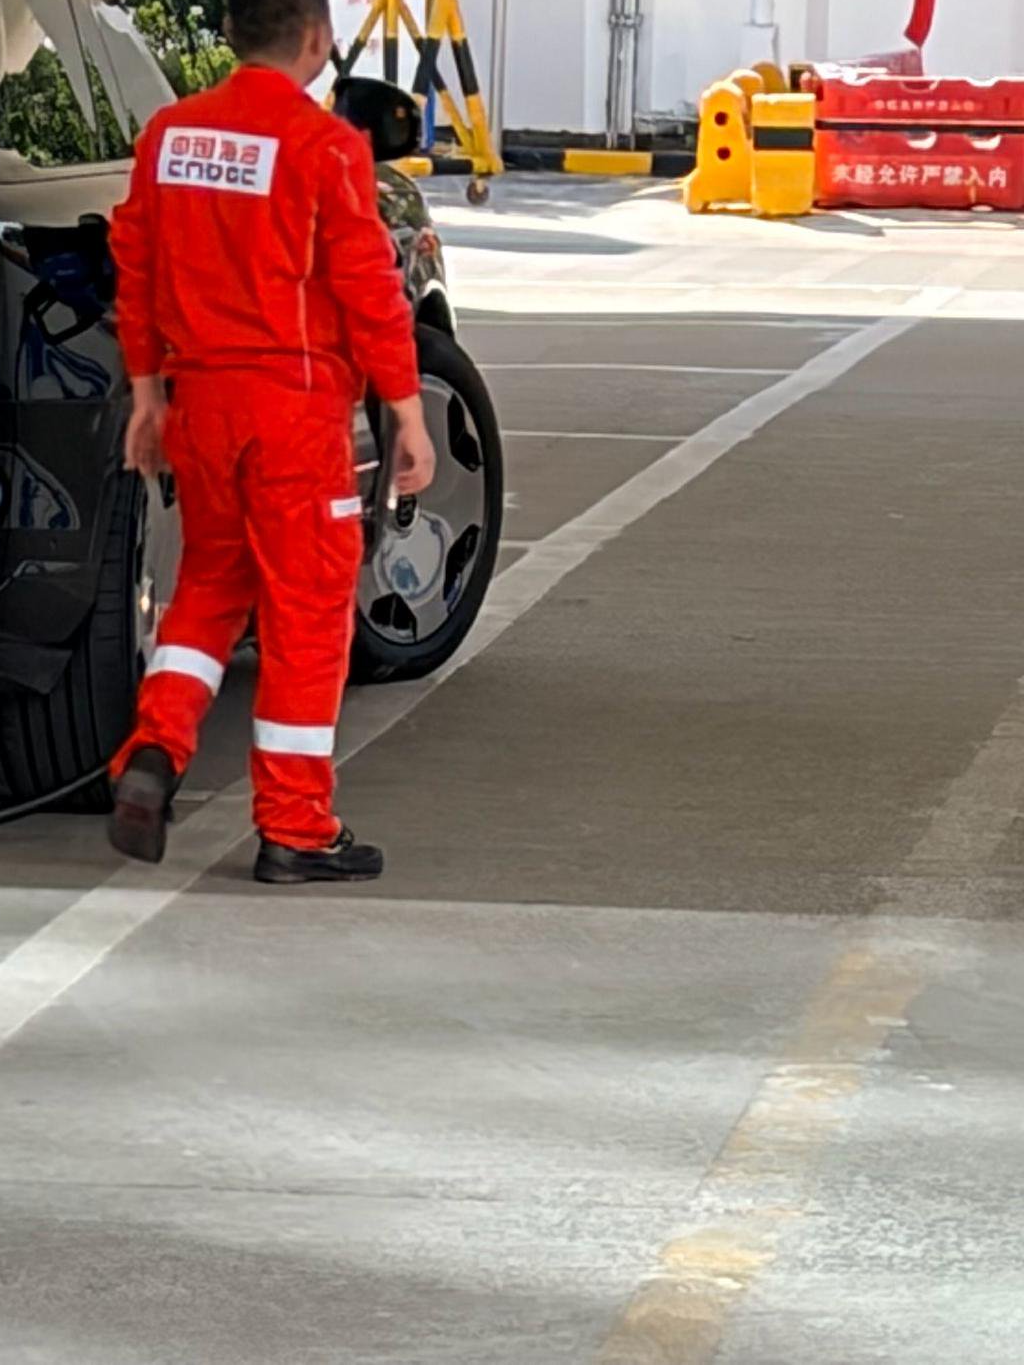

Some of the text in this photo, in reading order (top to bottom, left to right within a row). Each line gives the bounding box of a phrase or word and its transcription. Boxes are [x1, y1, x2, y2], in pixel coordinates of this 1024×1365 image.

[833, 164, 1007, 187] 未经允许严禁入内
